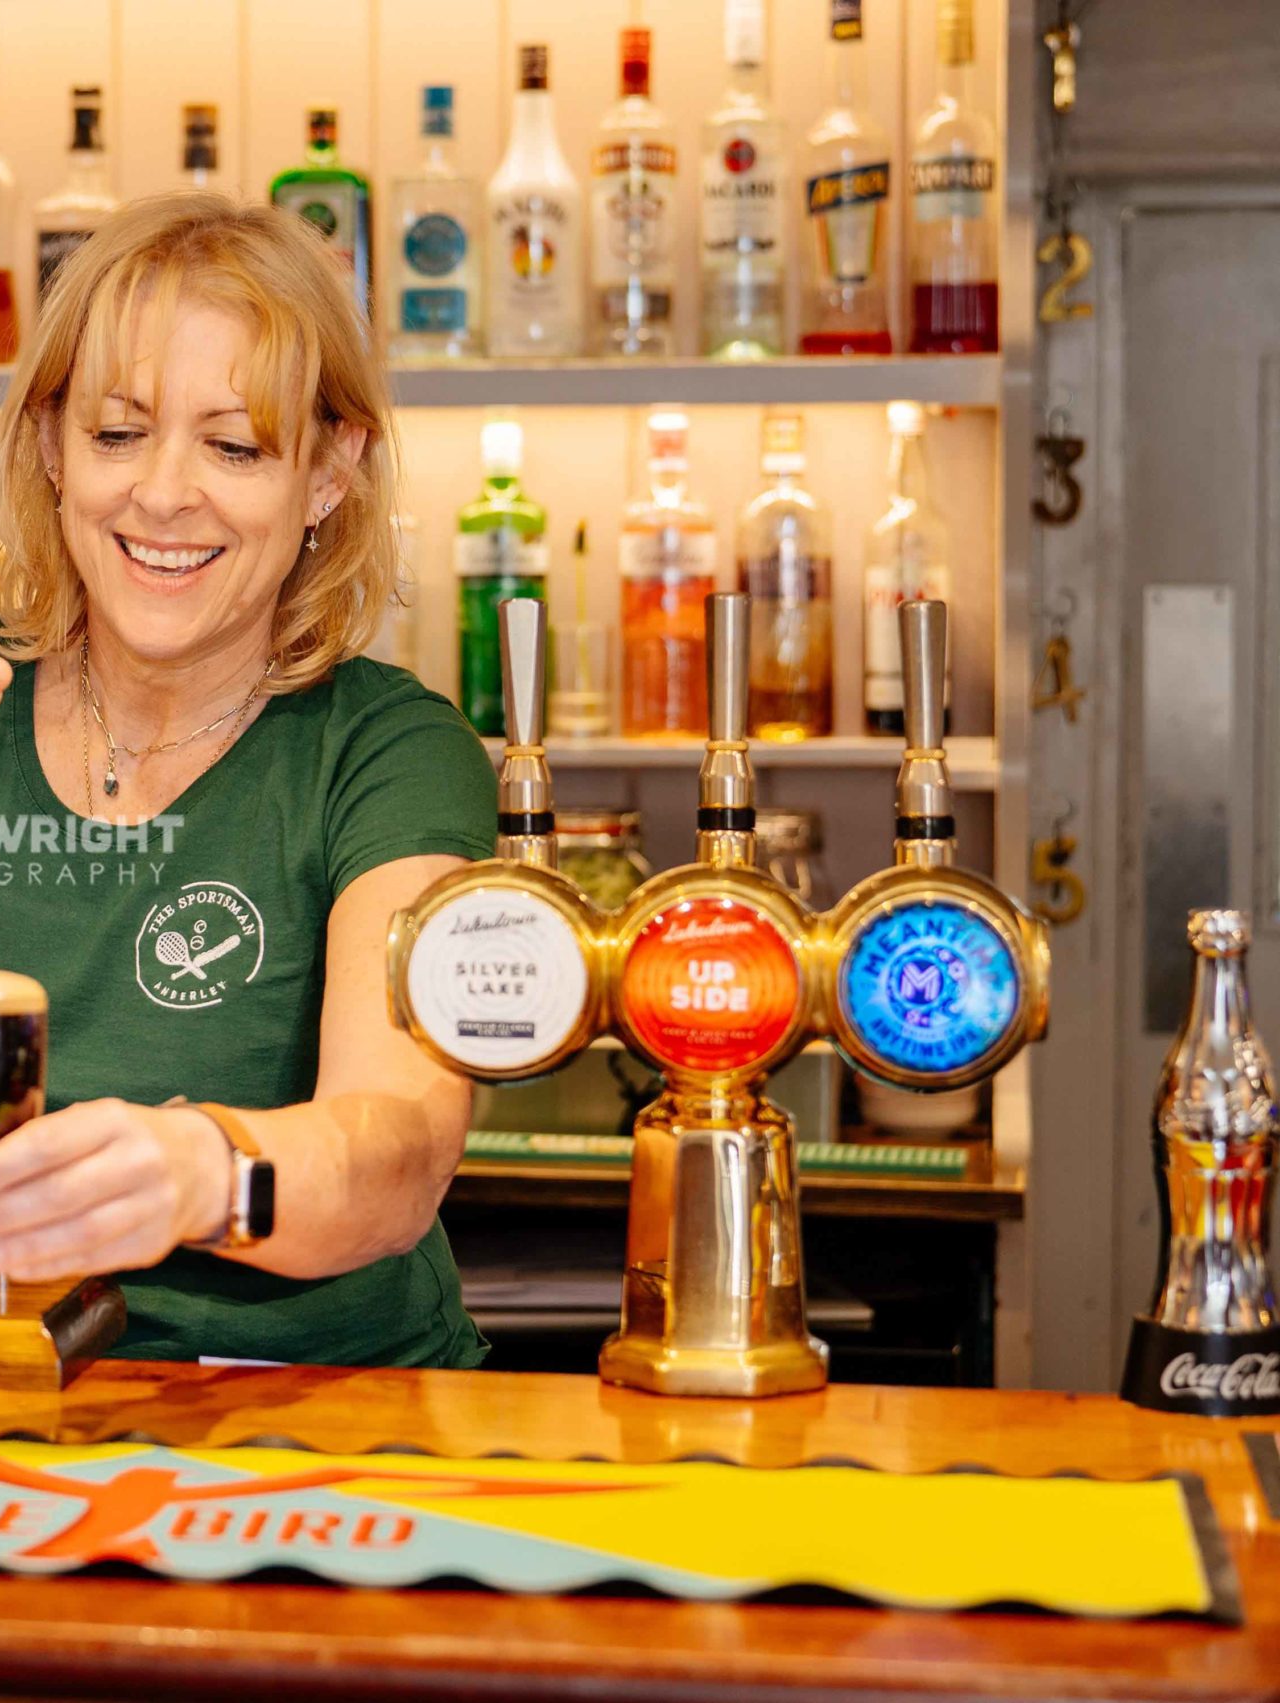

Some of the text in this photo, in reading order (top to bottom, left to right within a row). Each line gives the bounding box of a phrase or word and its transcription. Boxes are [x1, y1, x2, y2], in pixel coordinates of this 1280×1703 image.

[1037, 232, 1093, 323] 2
[1032, 437, 1085, 527] 3
[1030, 635, 1087, 724] 4
[1031, 838, 1086, 925] 5
[148, 890, 257, 936] THE SPORTSMAN
[456, 961, 538, 977] SILVER
[467, 982, 525, 996] LAKE
[687, 959, 737, 986] UP
[669, 984, 750, 1012] SIDE
[167, 1503, 415, 1548] BIRD
